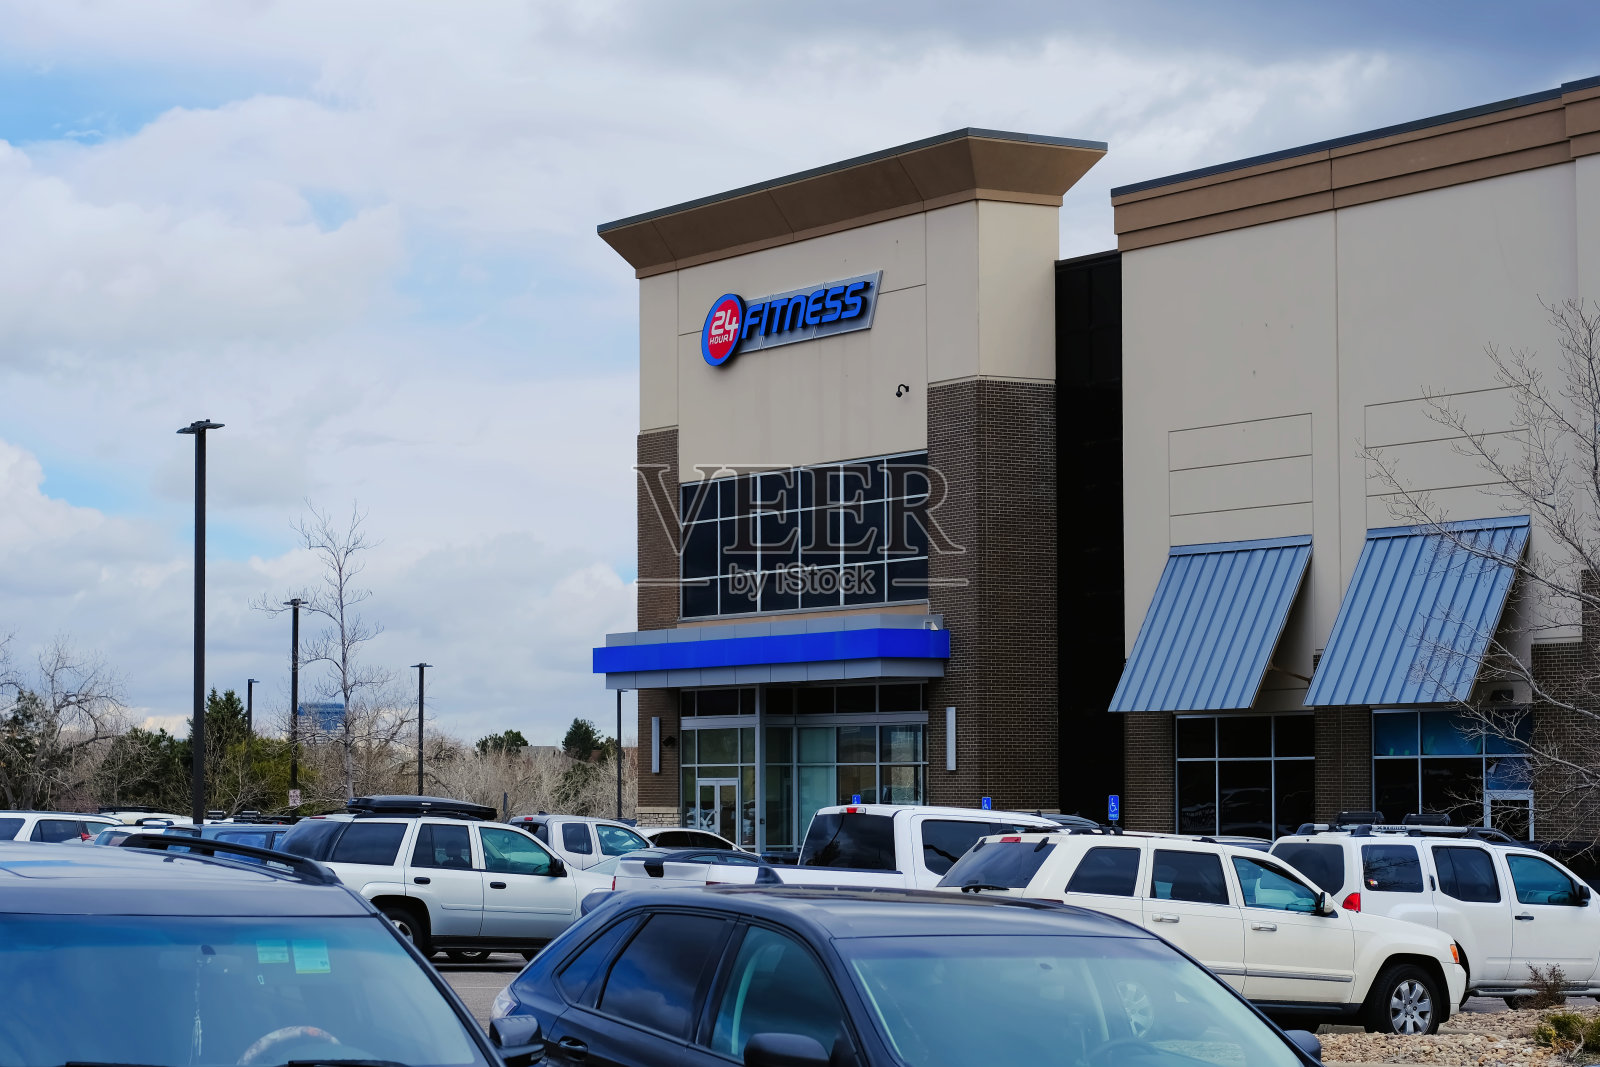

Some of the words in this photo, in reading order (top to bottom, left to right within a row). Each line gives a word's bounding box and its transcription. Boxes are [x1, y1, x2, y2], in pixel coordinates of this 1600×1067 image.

[710, 309, 739, 342] 24
[741, 281, 866, 340] FITNESS
[709, 334, 729, 345] HOUR
